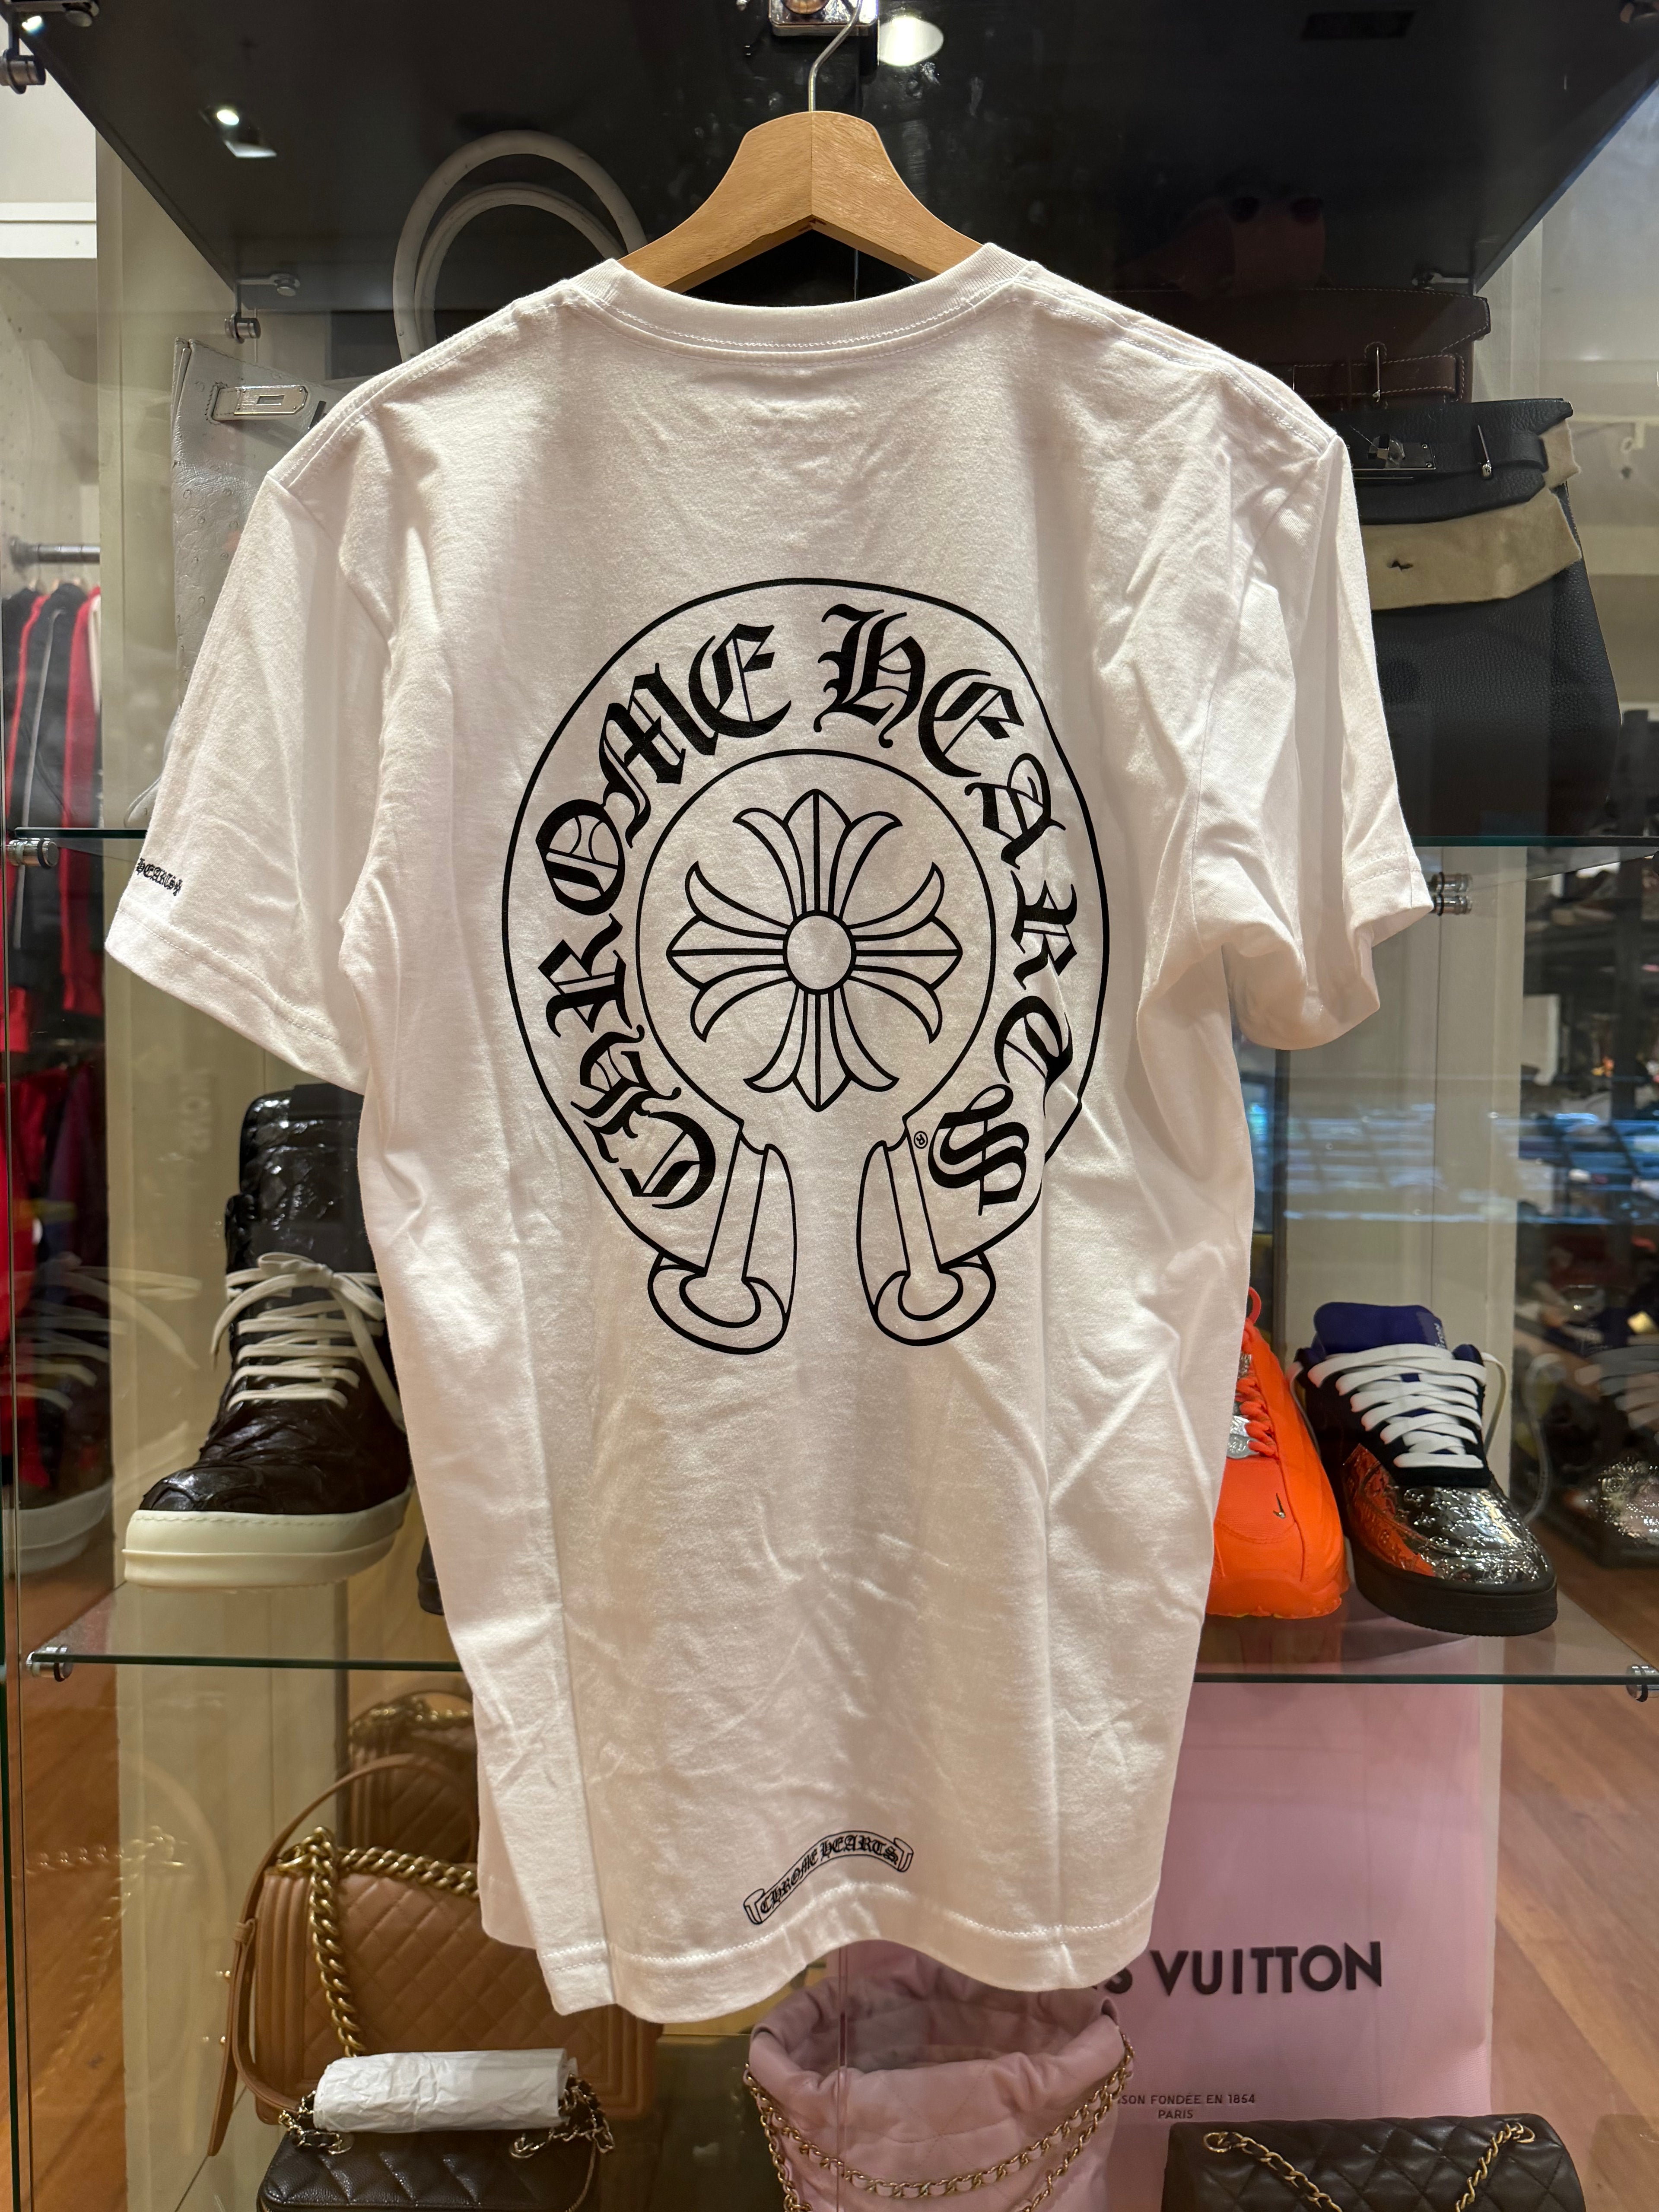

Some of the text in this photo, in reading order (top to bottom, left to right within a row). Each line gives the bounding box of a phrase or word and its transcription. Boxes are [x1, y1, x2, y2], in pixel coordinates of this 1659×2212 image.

[760, 1834, 899, 1913] CHROME HEARTS
[1150, 1941, 1382, 1996] VUITTON
[1158, 2110, 1194, 2119] PARIS
[1206, 2094, 1223, 2104] EN
[1227, 2094, 1255, 2104] 1854
